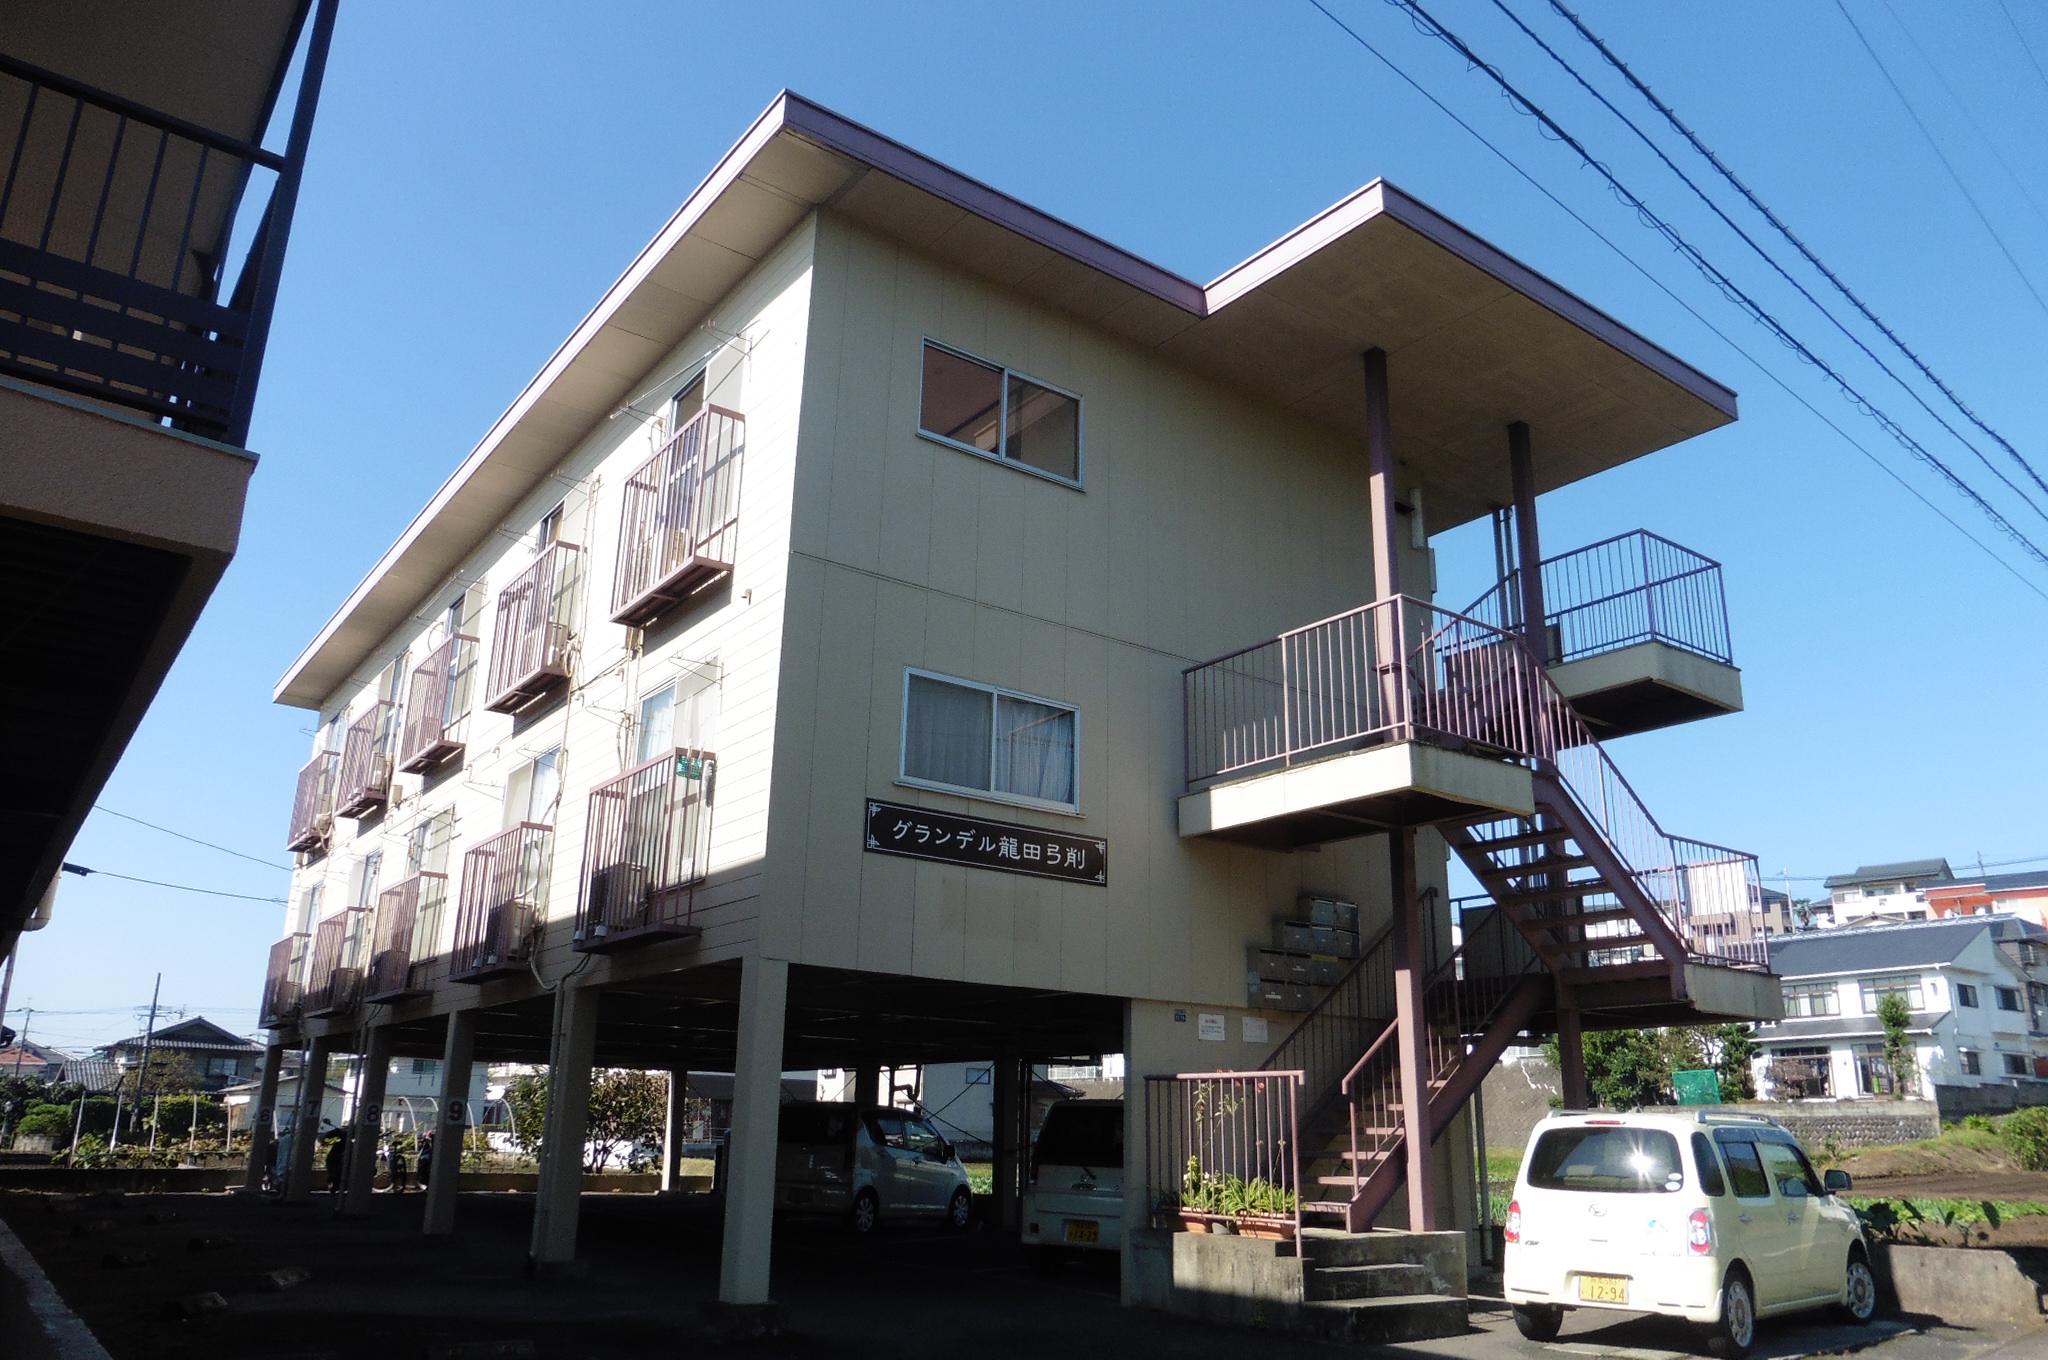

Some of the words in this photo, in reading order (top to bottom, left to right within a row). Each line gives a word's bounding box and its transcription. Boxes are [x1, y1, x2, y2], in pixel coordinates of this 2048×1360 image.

[893, 820, 1085, 870] グランデル龍田弓削
[260, 1109, 270, 1122] 6
[366, 1105, 379, 1122] 8
[449, 1101, 463, 1121] 9
